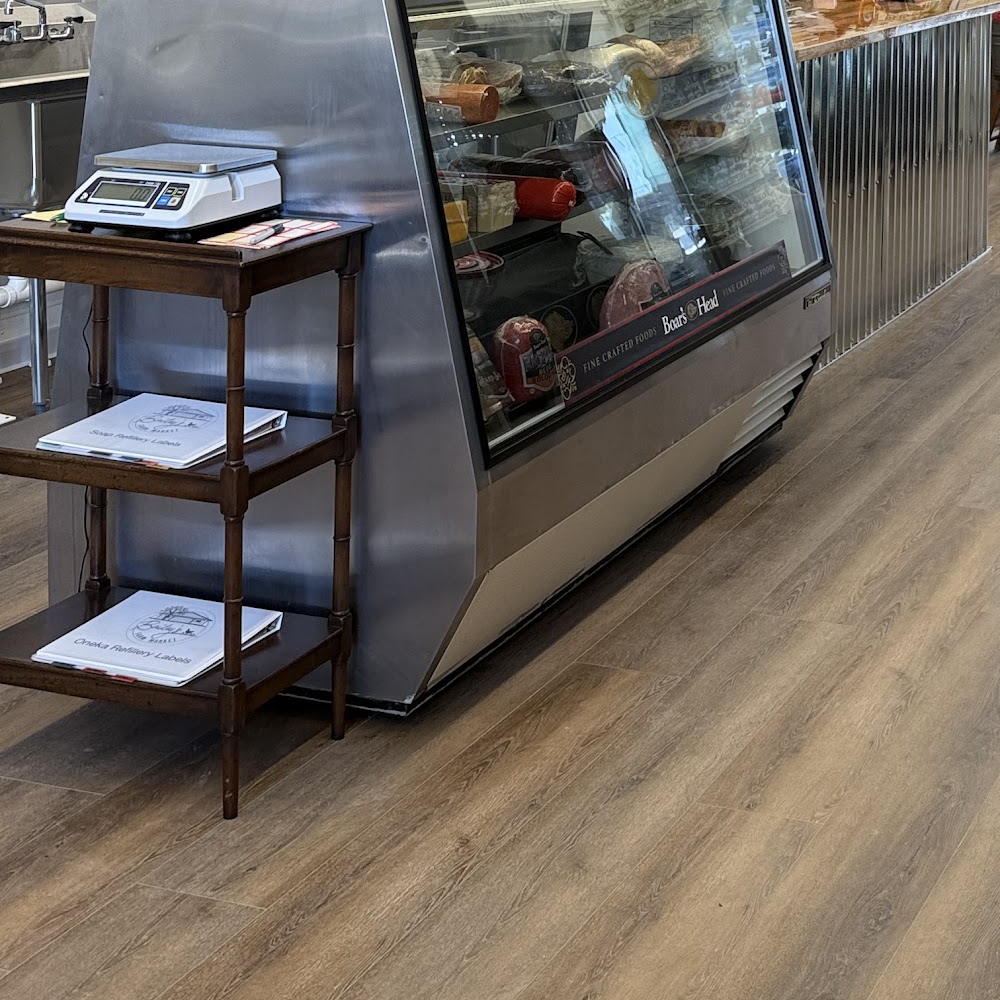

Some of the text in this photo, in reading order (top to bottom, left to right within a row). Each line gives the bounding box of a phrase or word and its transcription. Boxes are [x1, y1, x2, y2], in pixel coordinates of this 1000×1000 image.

[722, 264, 776, 297] FINE CRAFTED FOODS
[661, 289, 719, 335] Boar's Head
[582, 327, 657, 373] FINE CRAFTED FOODS
[89, 429, 114, 438] Soap
[150, 438, 182, 447] Labels
[74, 638, 192, 665] Oneka Refillery Labels
